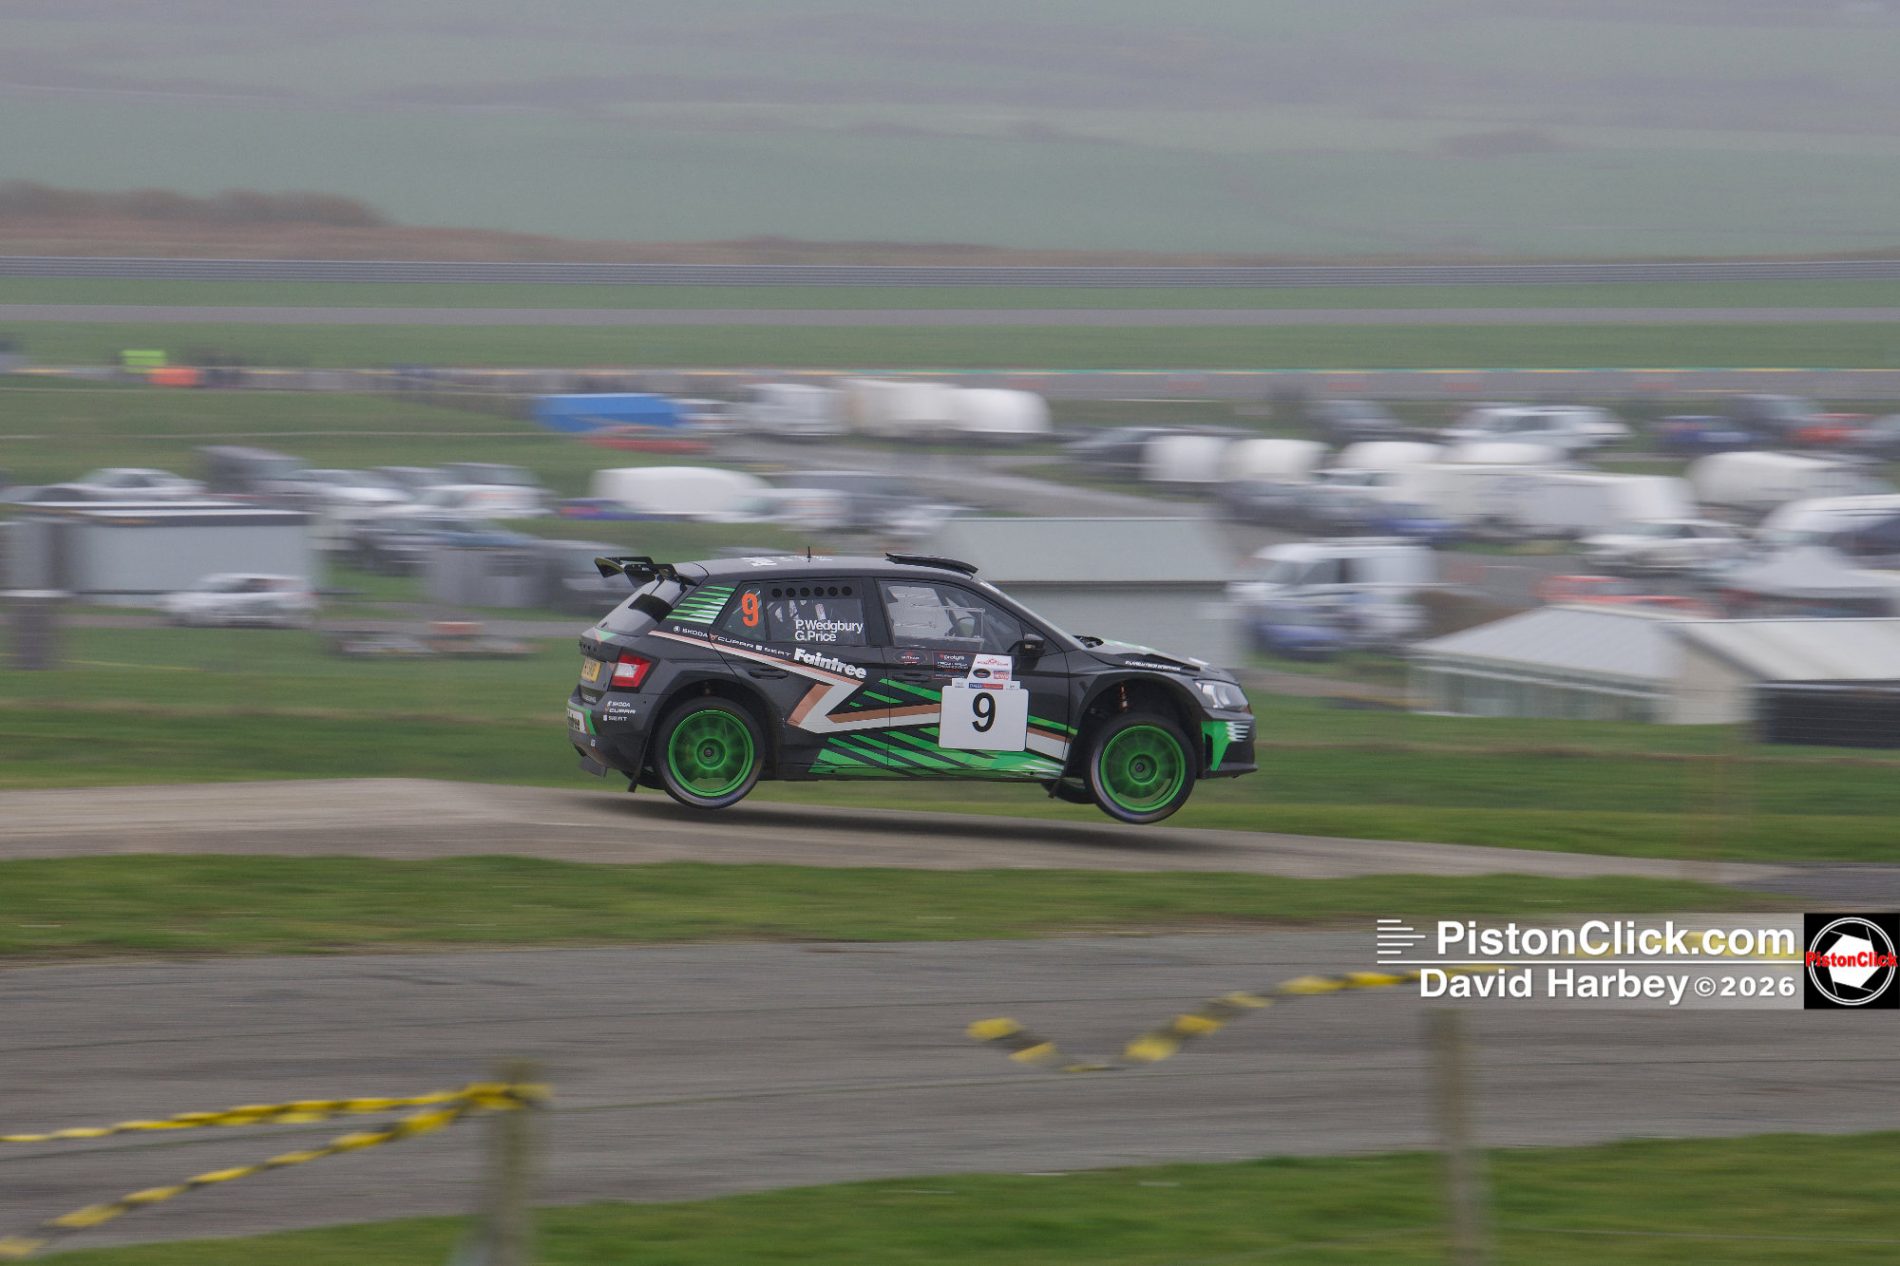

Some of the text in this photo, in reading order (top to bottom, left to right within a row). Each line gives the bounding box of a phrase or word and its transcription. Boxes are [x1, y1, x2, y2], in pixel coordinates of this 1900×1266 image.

[741, 593, 760, 627] 9
[794, 630, 837, 642] G.Price
[795, 619, 864, 634] P.Wedgbury
[793, 647, 868, 679] Faintree
[972, 692, 996, 733] 9
